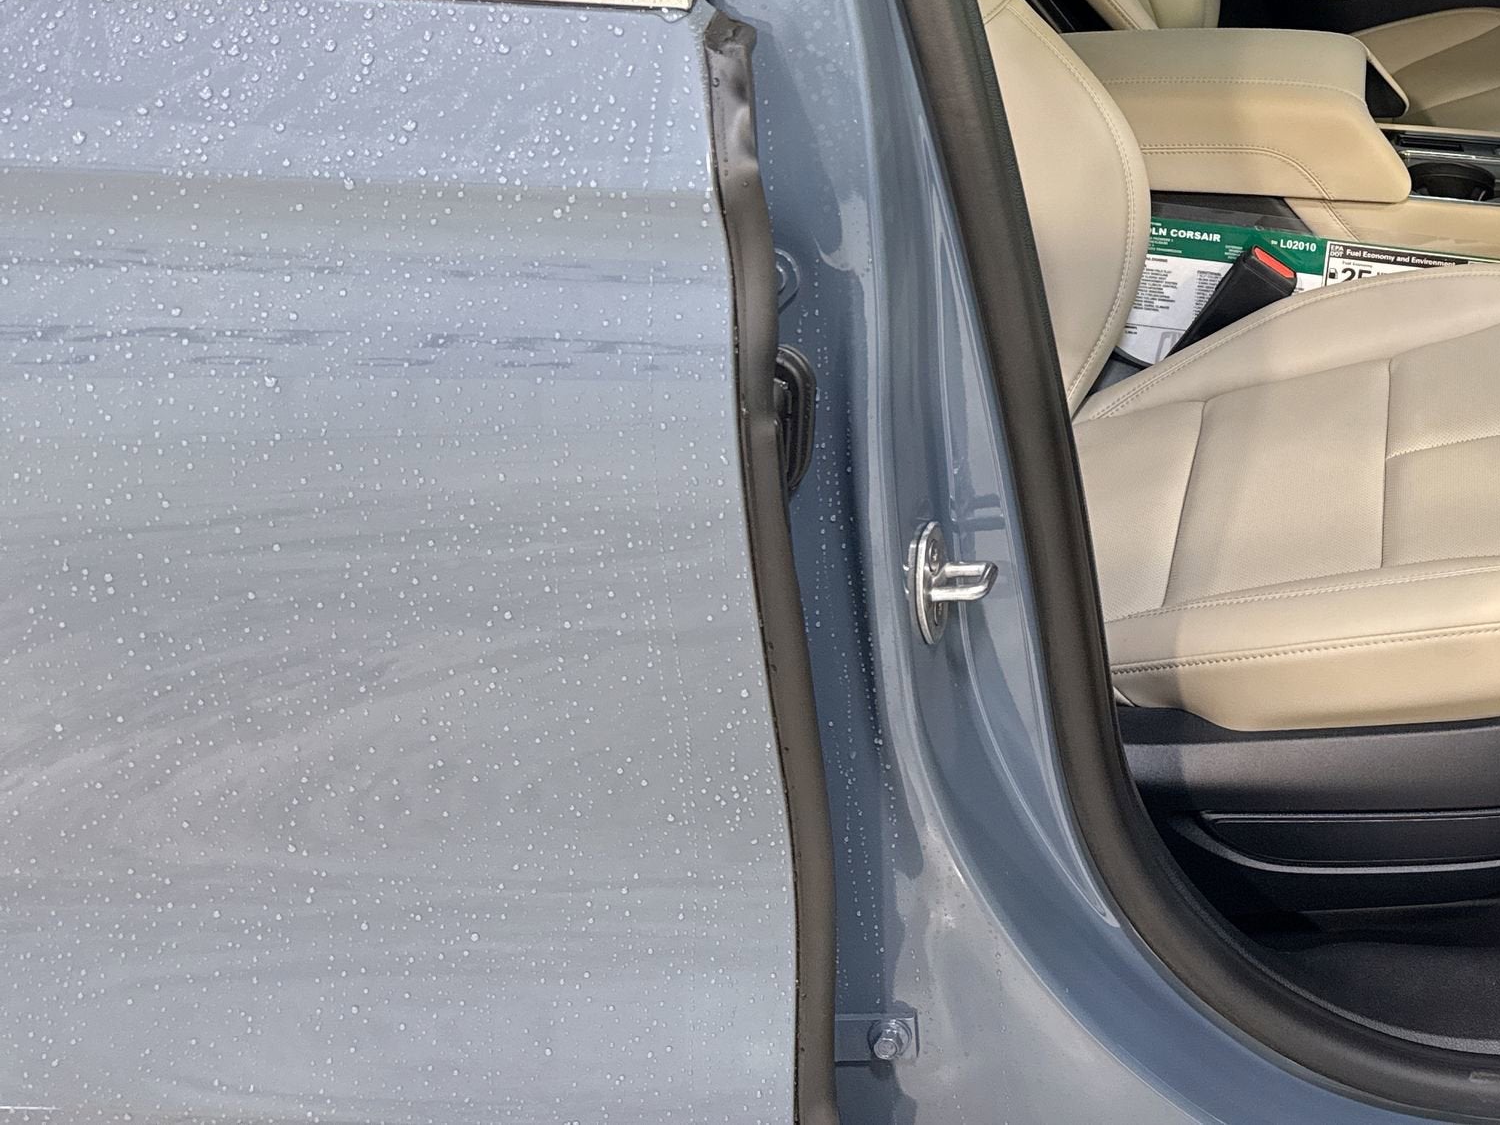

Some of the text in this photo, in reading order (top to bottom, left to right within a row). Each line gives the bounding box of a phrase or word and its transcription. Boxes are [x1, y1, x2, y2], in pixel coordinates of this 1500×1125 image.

[1170, 229, 1221, 242] CORSAIR
[1280, 239, 1317, 252] L02010
[1330, 250, 1344, 258] DOT
[1346, 248, 1362, 257] Fuel
[1363, 251, 1395, 263] Economy
